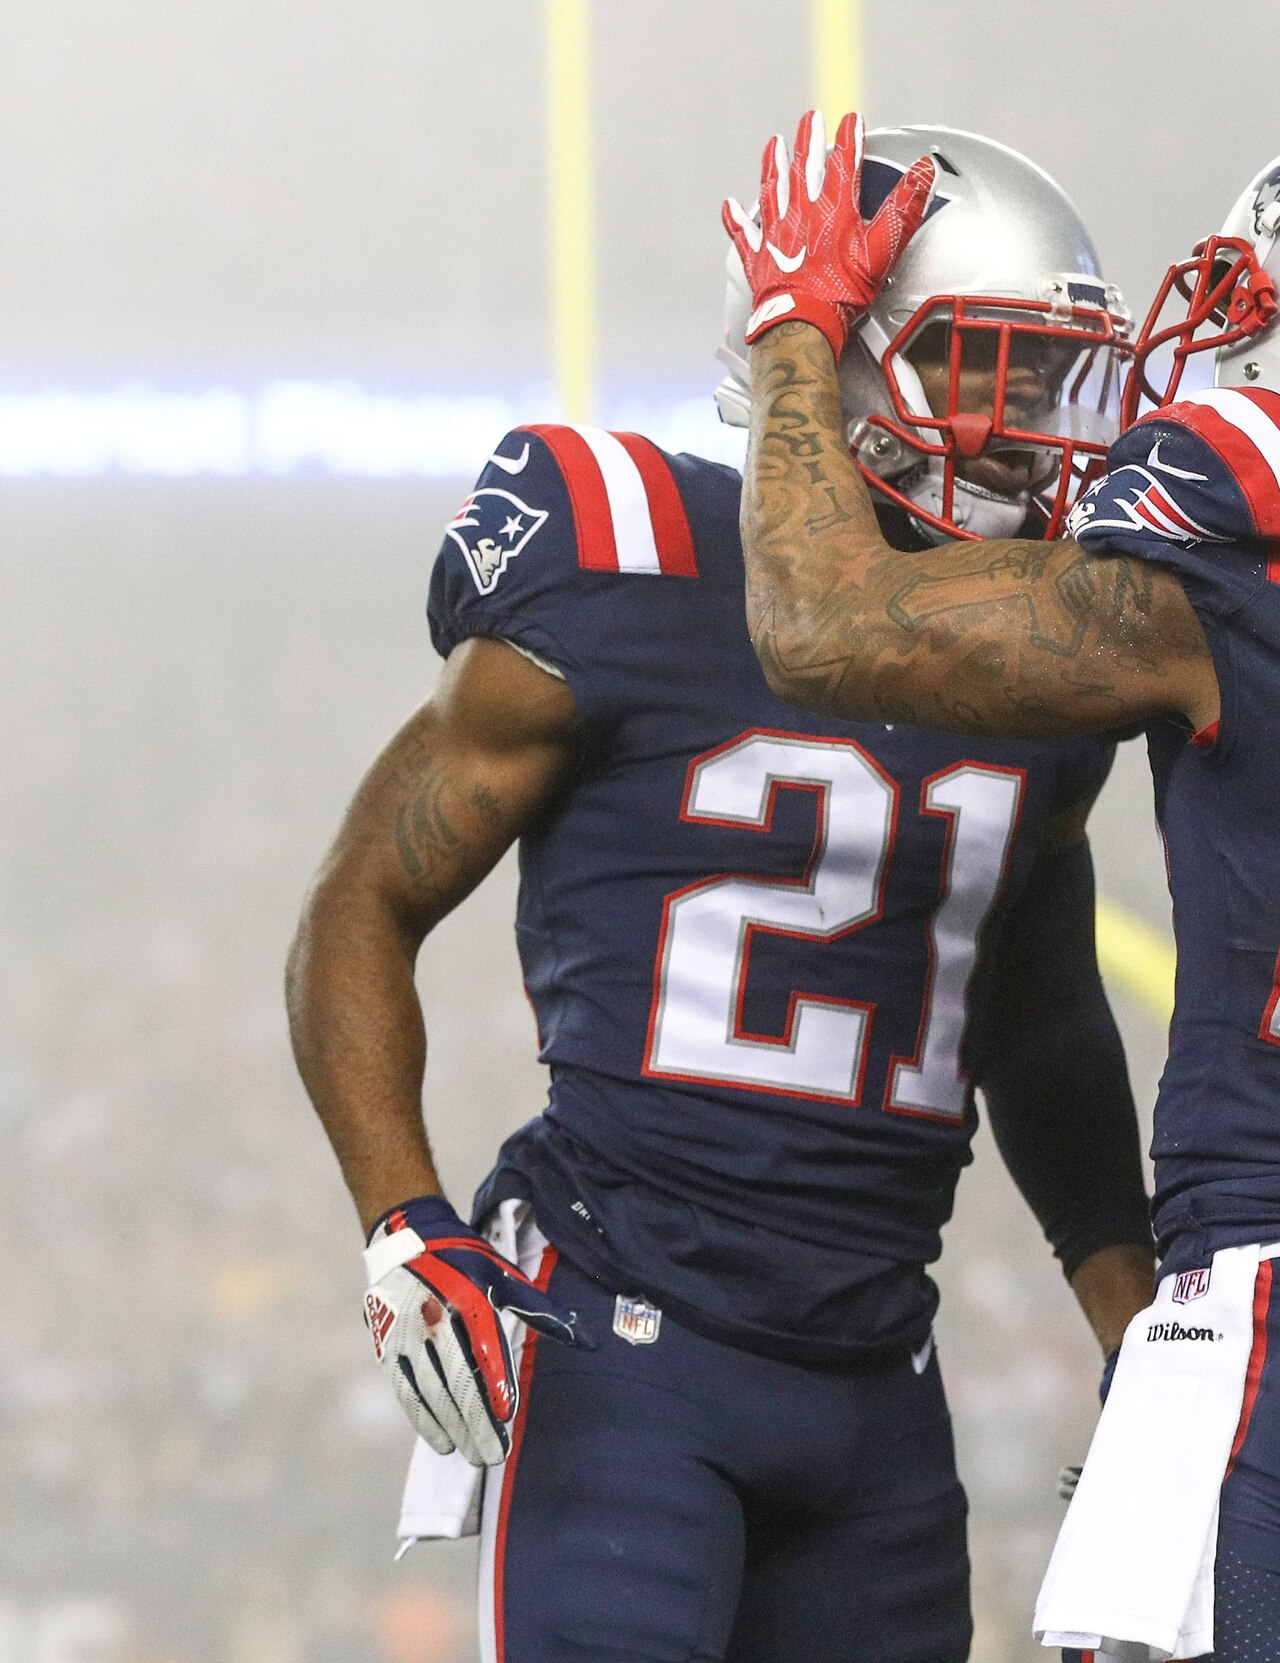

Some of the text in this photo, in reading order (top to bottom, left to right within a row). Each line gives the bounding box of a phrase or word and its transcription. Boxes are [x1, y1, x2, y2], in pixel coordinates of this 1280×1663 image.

[641, 727, 1028, 1126] 21
[1176, 1271, 1206, 1299] NFL
[622, 1313, 652, 1336] NFL
[1147, 1322, 1214, 1342] Wilson
